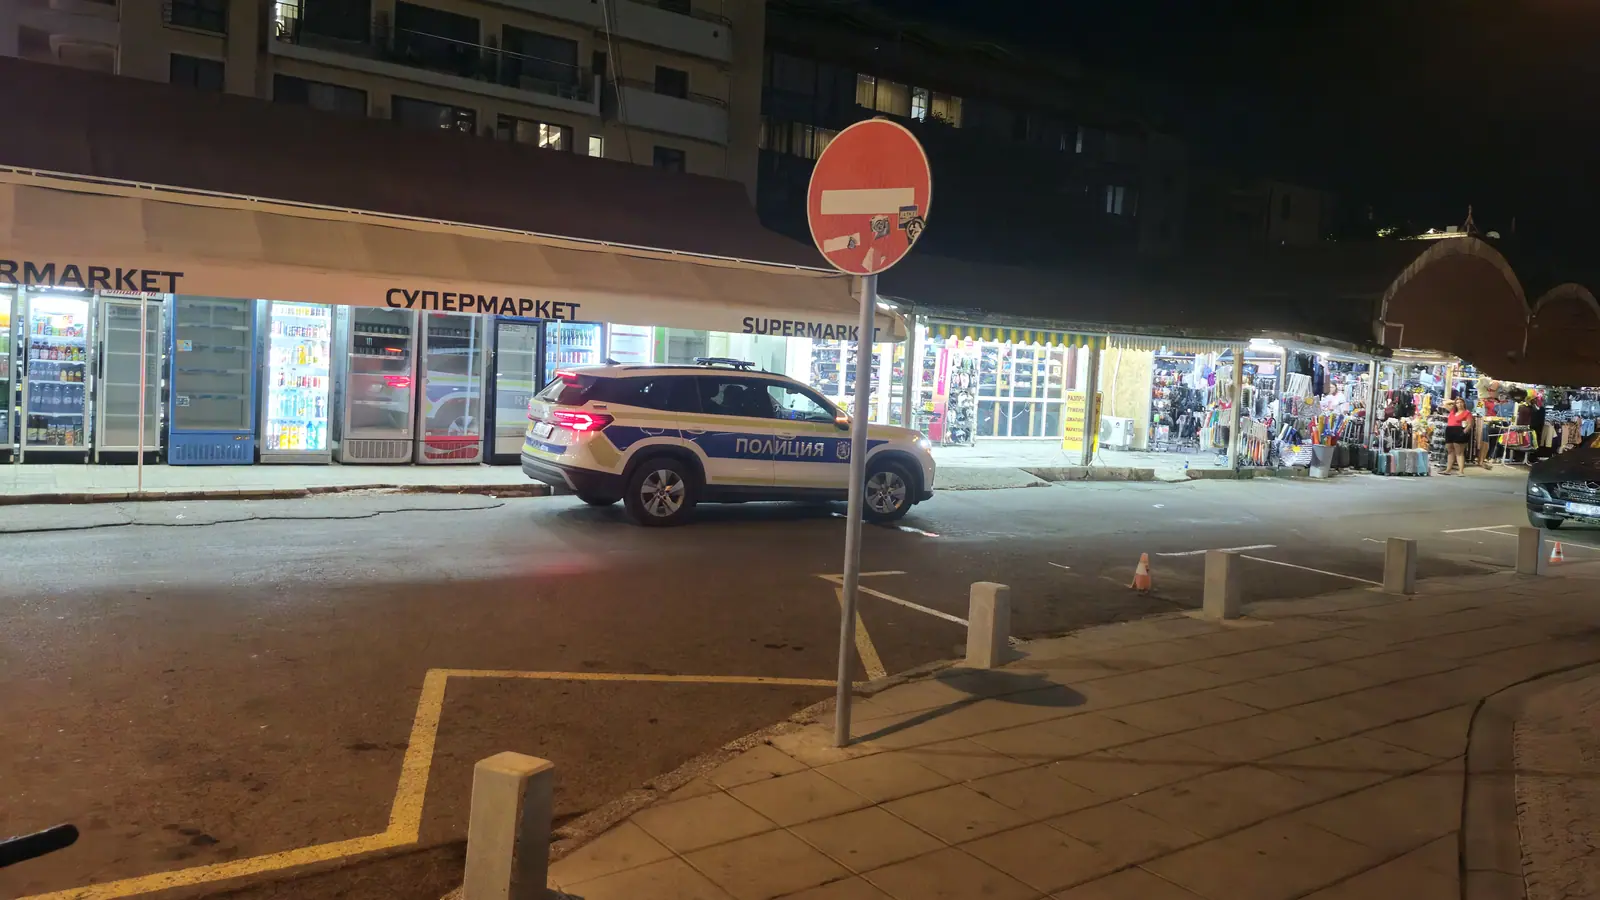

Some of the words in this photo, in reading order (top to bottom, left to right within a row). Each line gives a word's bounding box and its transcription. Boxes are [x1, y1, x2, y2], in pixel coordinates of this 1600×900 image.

[386, 288, 581, 320] СУПЕРМАРКЕТ
[742, 317, 881, 342] SUPERMARKT
[735, 438, 825, 458] ПОЛИЦИЯ
